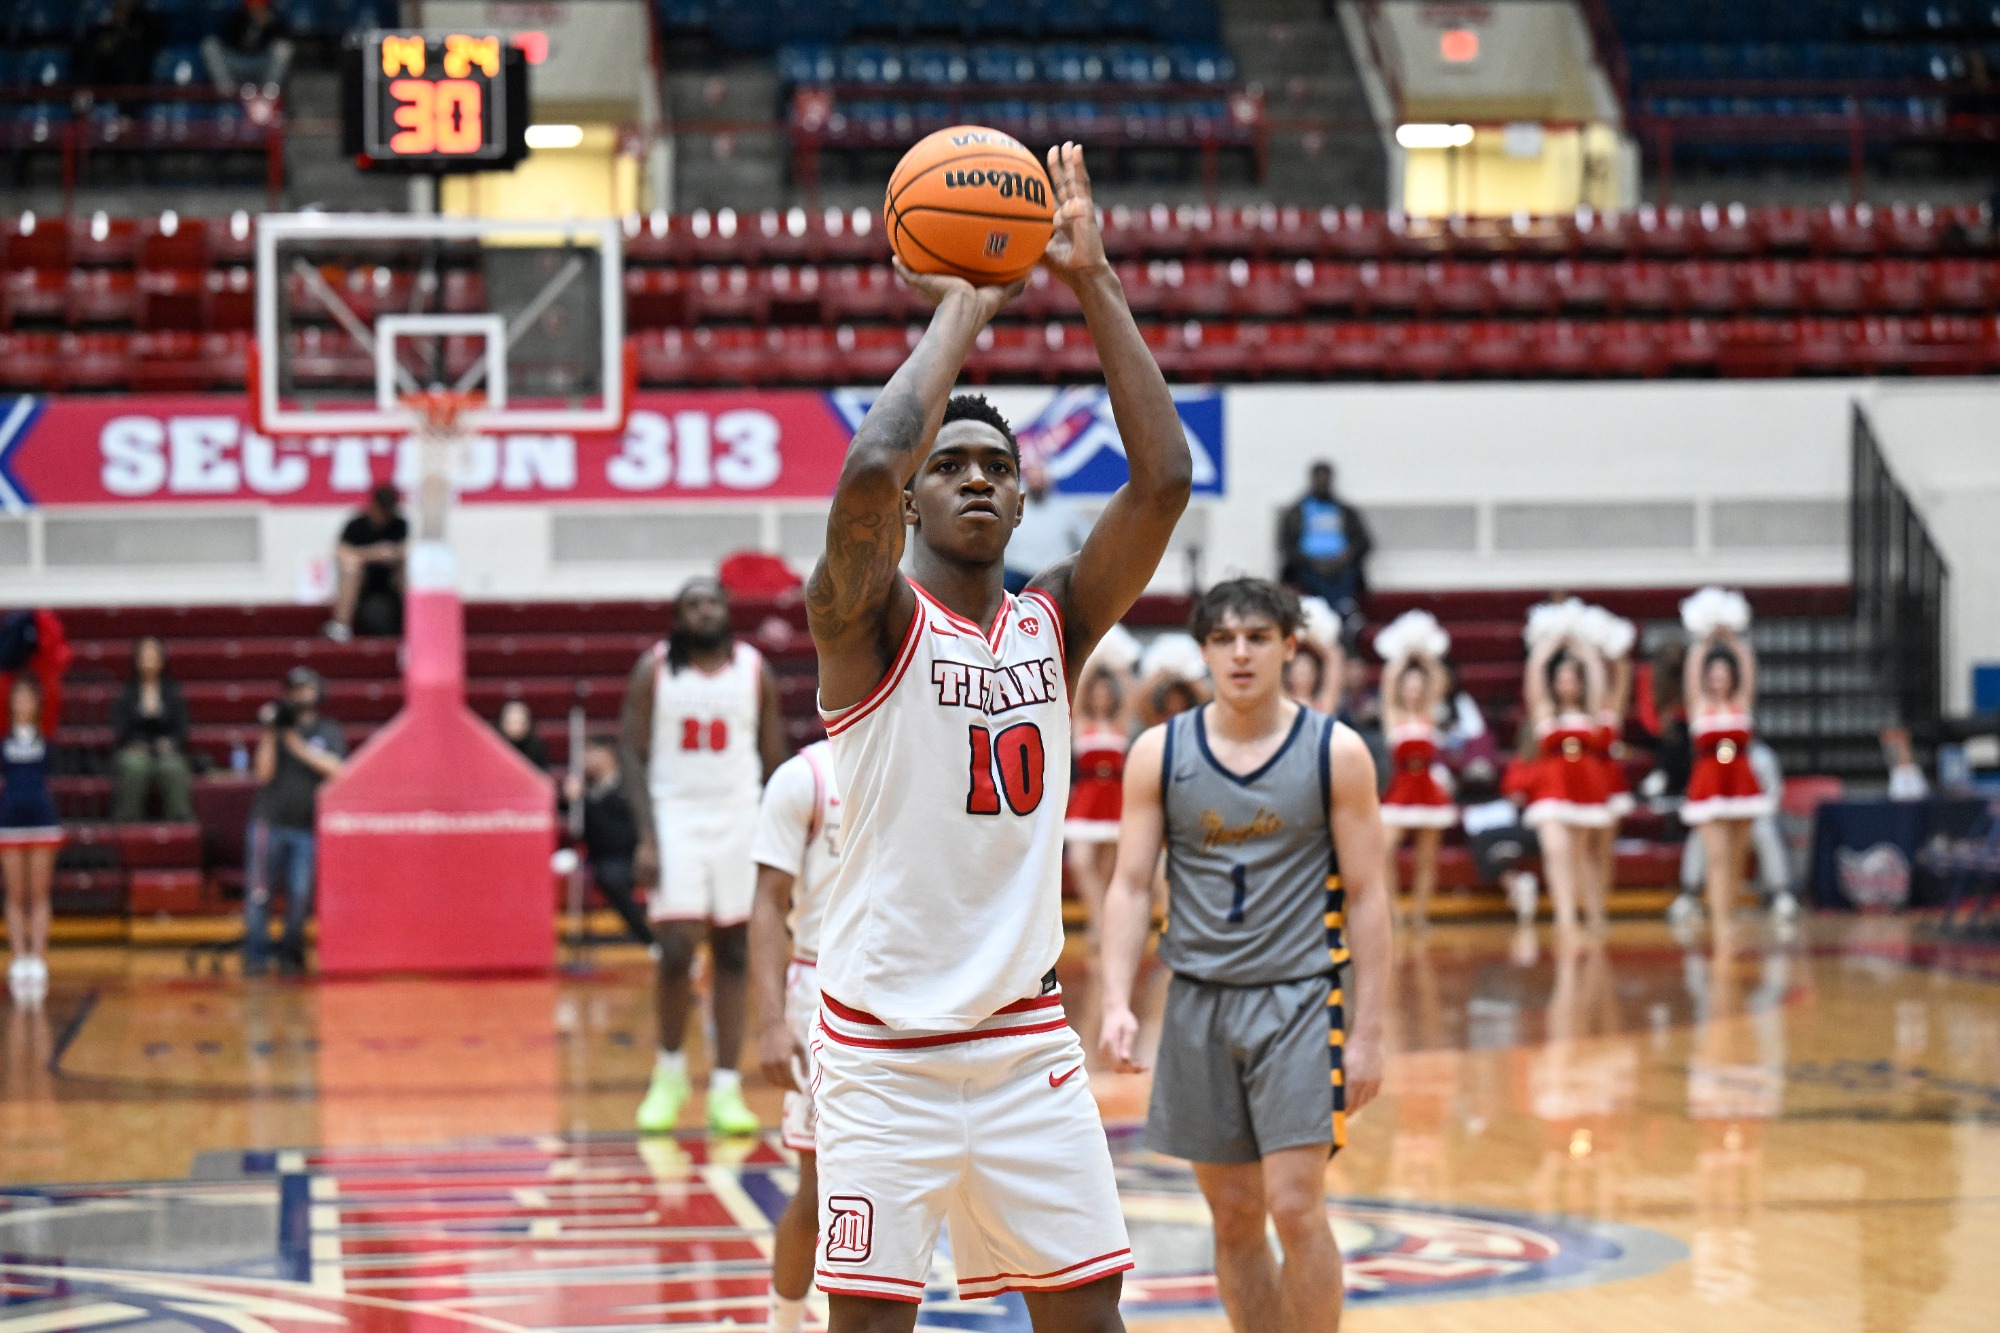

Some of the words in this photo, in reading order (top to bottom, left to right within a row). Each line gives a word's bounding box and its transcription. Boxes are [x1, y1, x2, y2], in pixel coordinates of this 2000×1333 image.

[389, 79, 482, 154] 30
[944, 169, 1047, 209] Wilson
[605, 409, 782, 491] 313
[932, 658, 1058, 716] TITANS
[966, 722, 1045, 816] 10
[1227, 863, 1246, 923] 1
